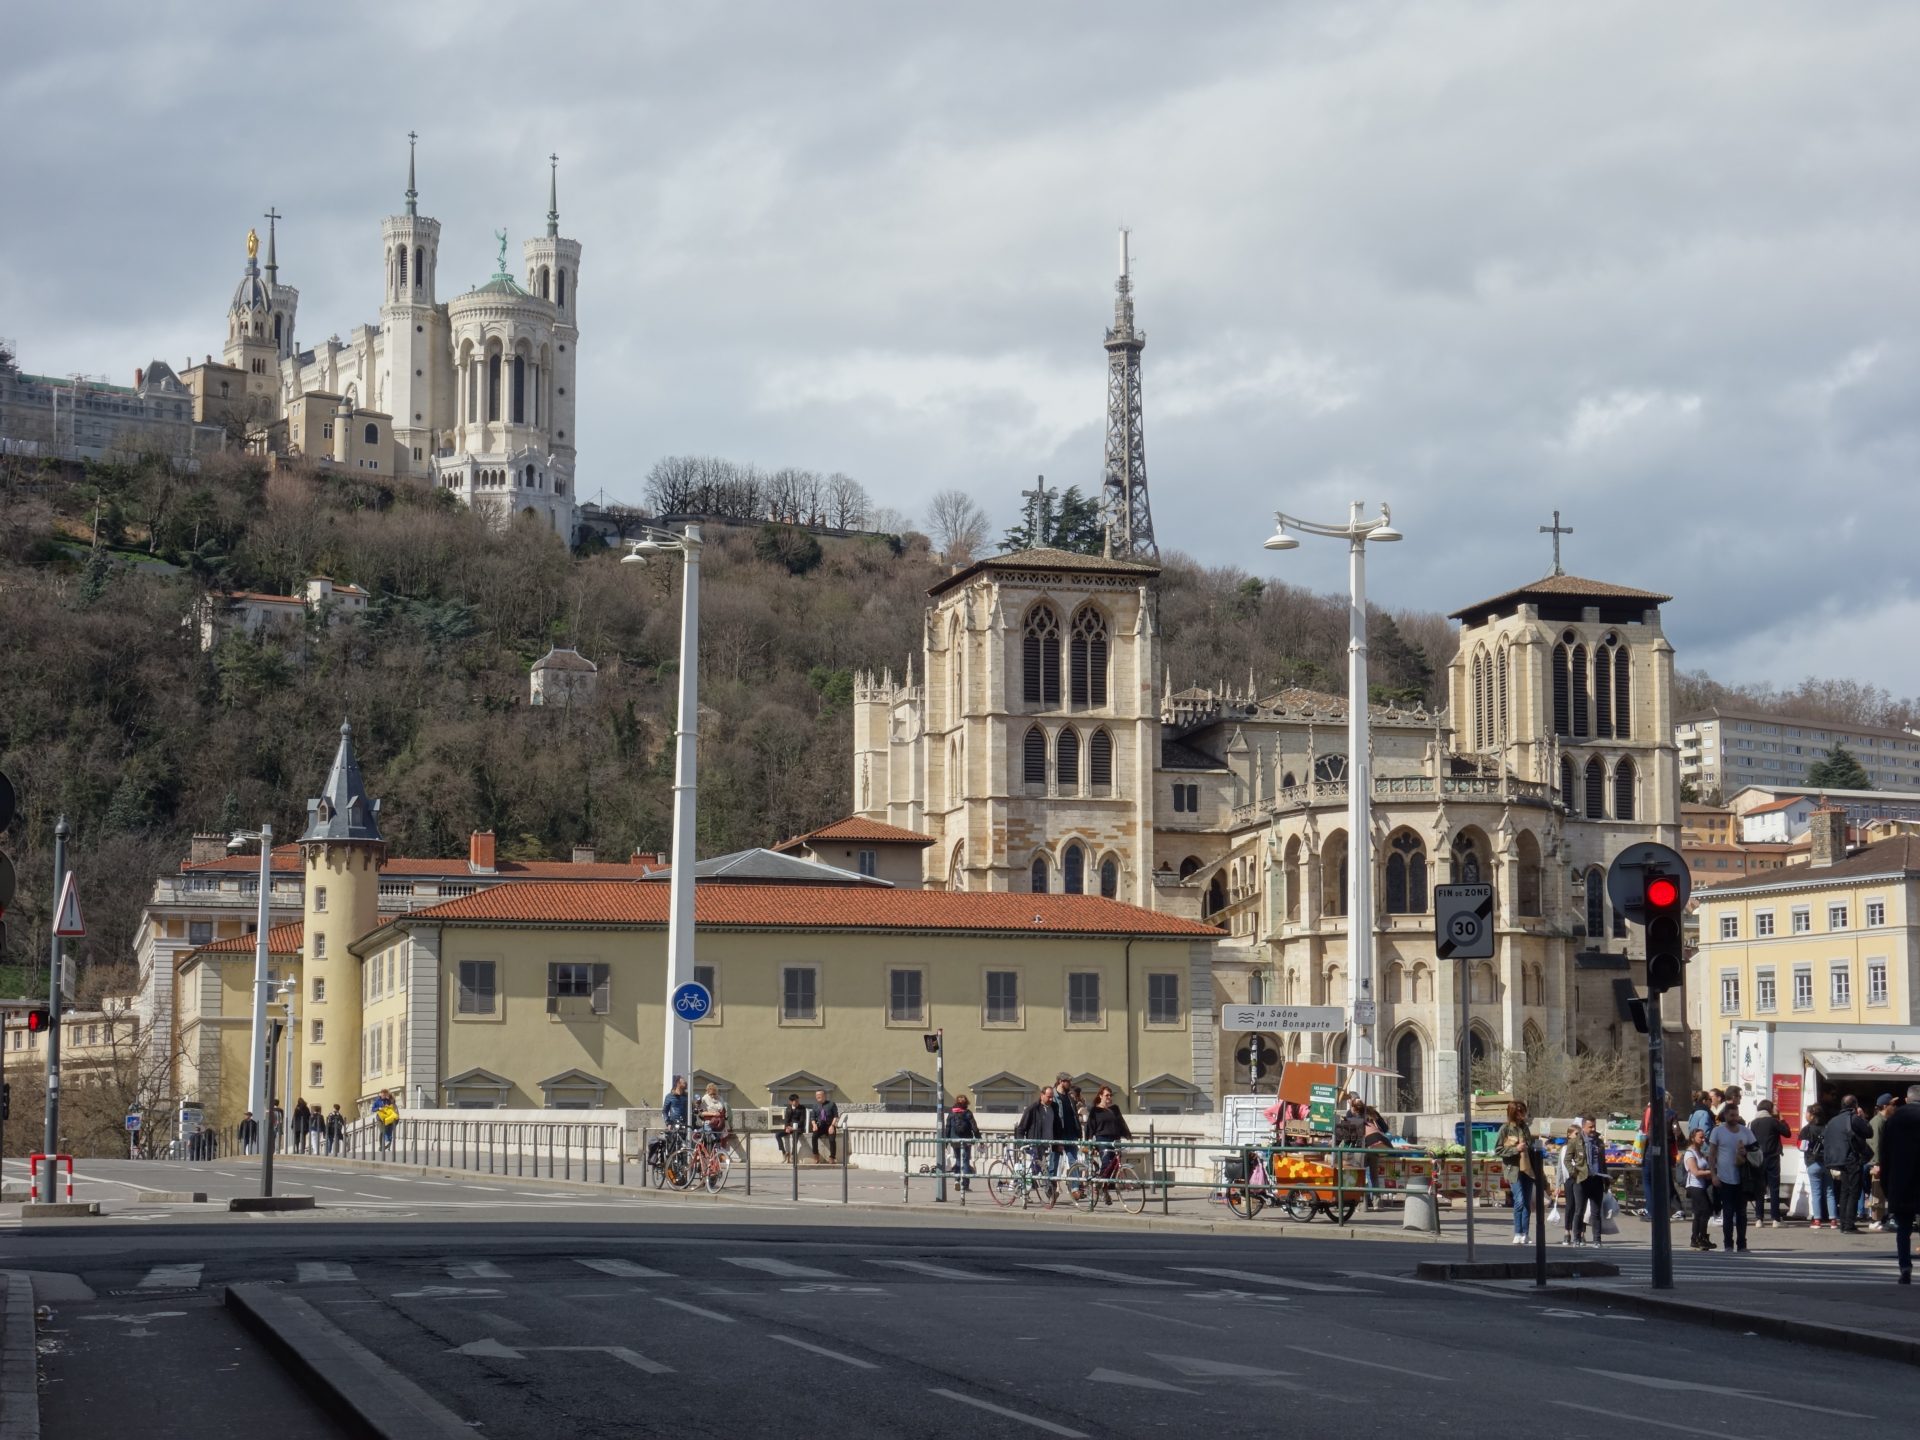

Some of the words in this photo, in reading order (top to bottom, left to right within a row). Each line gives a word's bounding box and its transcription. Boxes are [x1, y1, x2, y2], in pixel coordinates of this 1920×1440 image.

[1438, 889, 1453, 897] FIN
[1464, 888, 1489, 896] ZONE
[1454, 921, 1476, 936] 30
[1256, 1009, 1265, 1018] la
[1270, 1009, 1299, 1018] Saône
[1256, 1020, 1277, 1029] pont
[1282, 1019, 1331, 1029] Bonaparte
